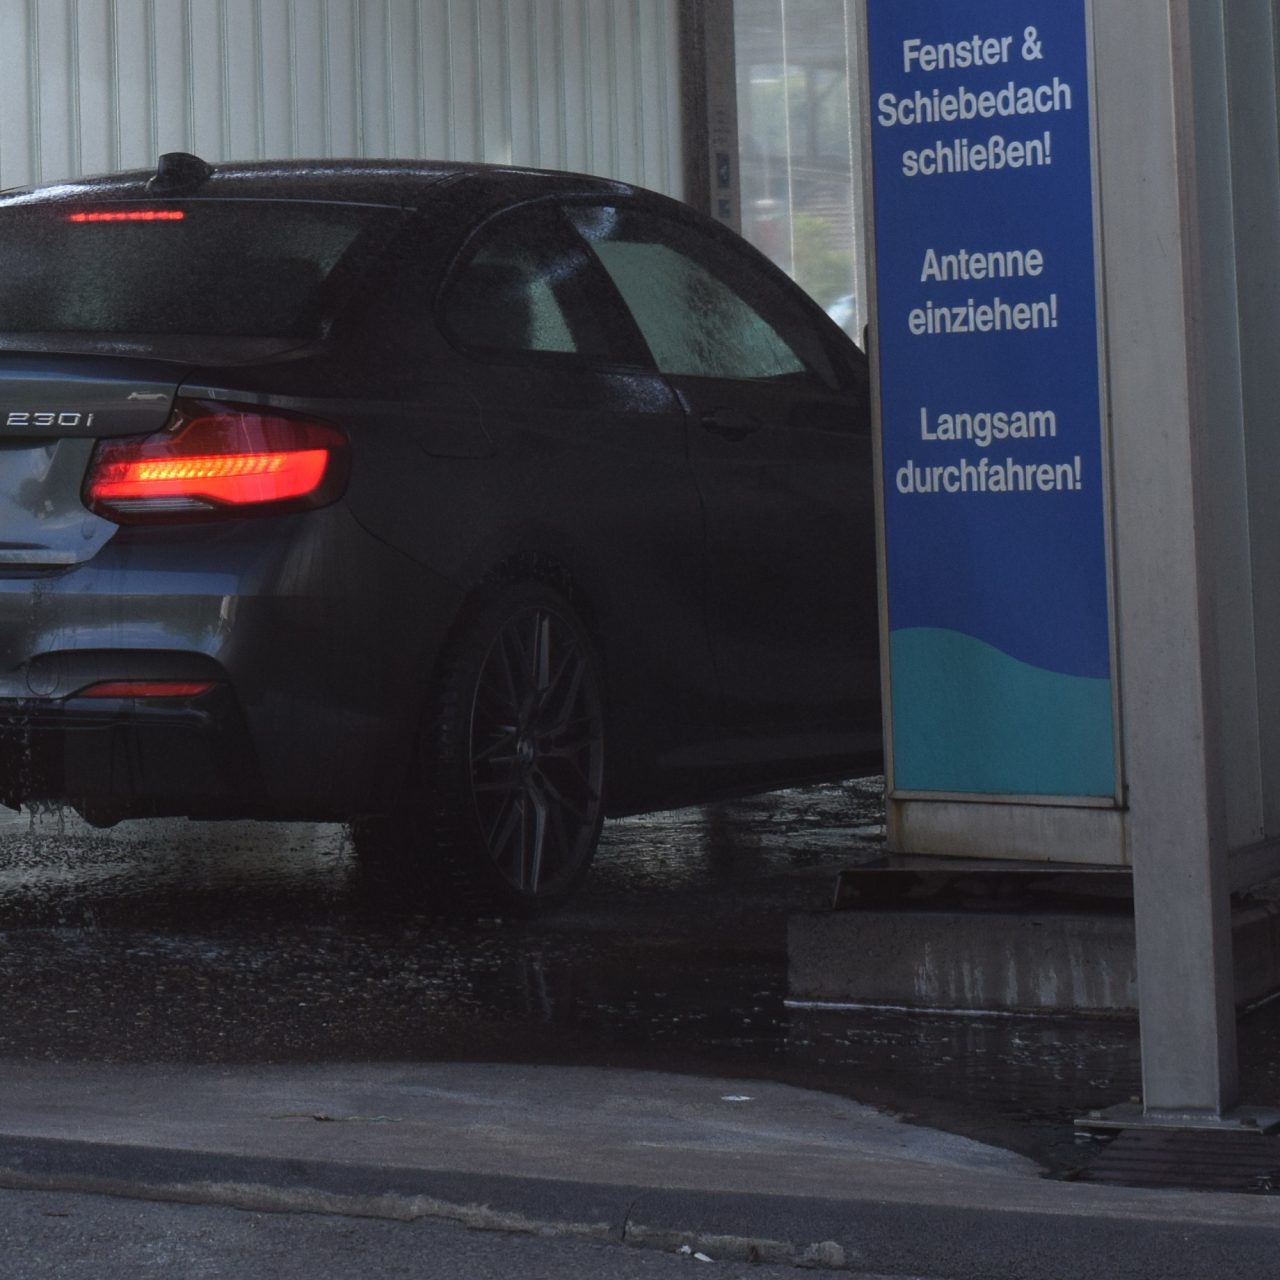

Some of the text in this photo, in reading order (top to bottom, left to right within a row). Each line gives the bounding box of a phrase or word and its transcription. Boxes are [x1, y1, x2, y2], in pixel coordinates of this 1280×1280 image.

[903, 25, 1043, 73] Fenster &
[877, 76, 1072, 127] Schiebedach
[902, 130, 1052, 177] schließen!
[920, 248, 1044, 282] Antenne
[908, 293, 1058, 335] einziehen!
[6, 412, 95, 427] 230i
[920, 407, 1056, 447] Langsam
[896, 455, 1082, 494] durchfahren!
